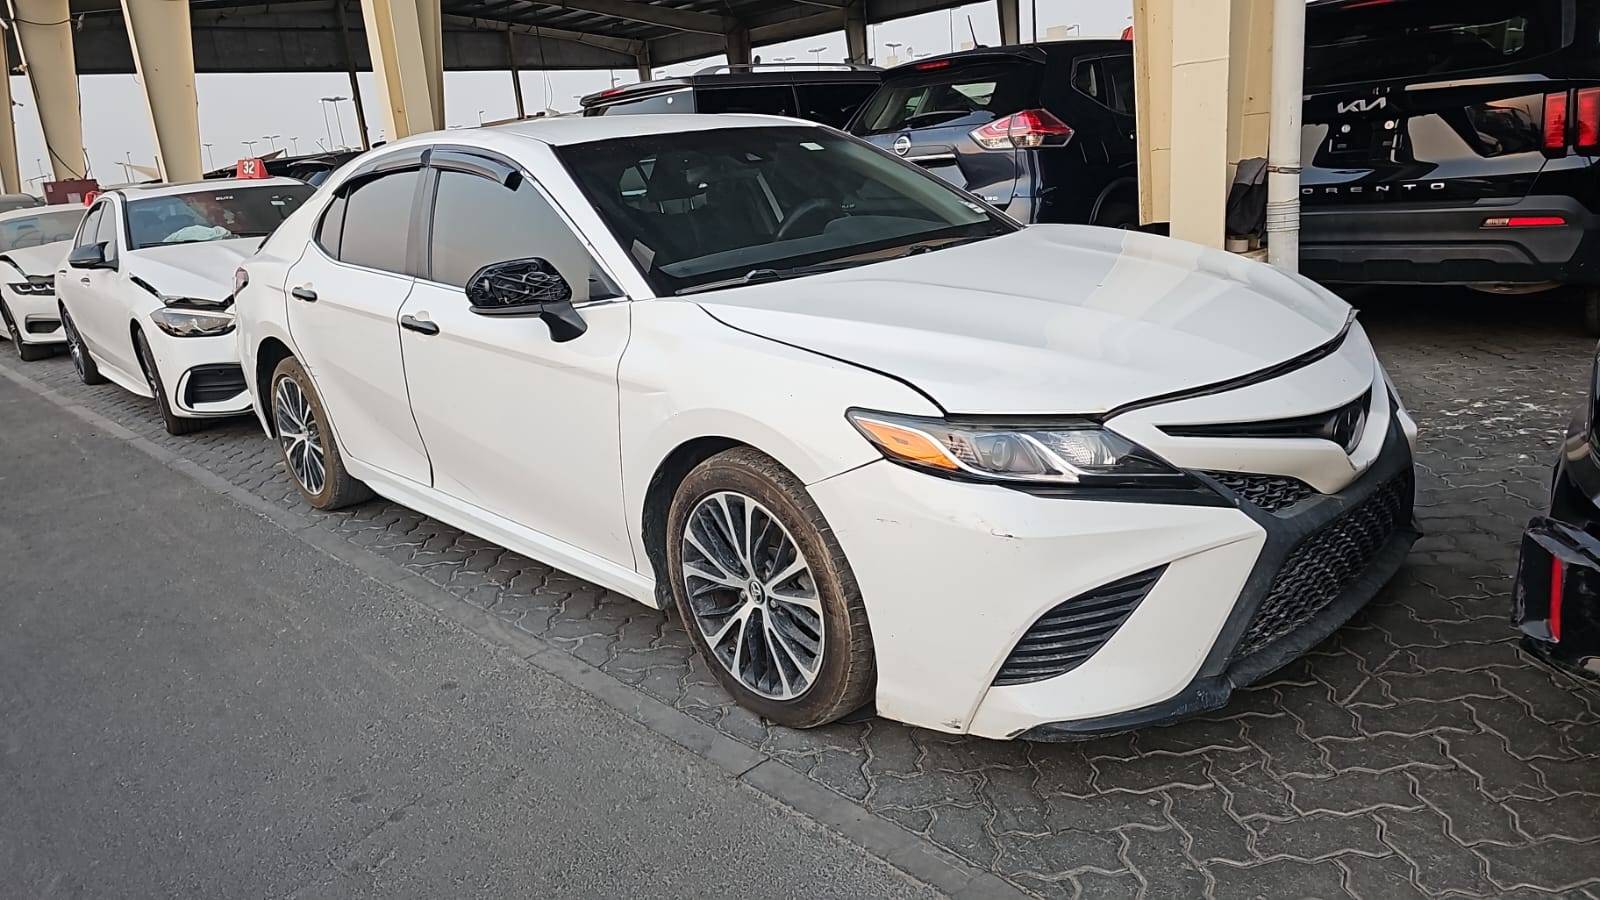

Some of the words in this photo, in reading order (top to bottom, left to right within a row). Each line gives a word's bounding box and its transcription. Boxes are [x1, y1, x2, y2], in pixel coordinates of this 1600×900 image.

[1337, 97, 1387, 114] KIA
[243, 161, 255, 174] 32
[1301, 182, 1446, 195] ORENTO
